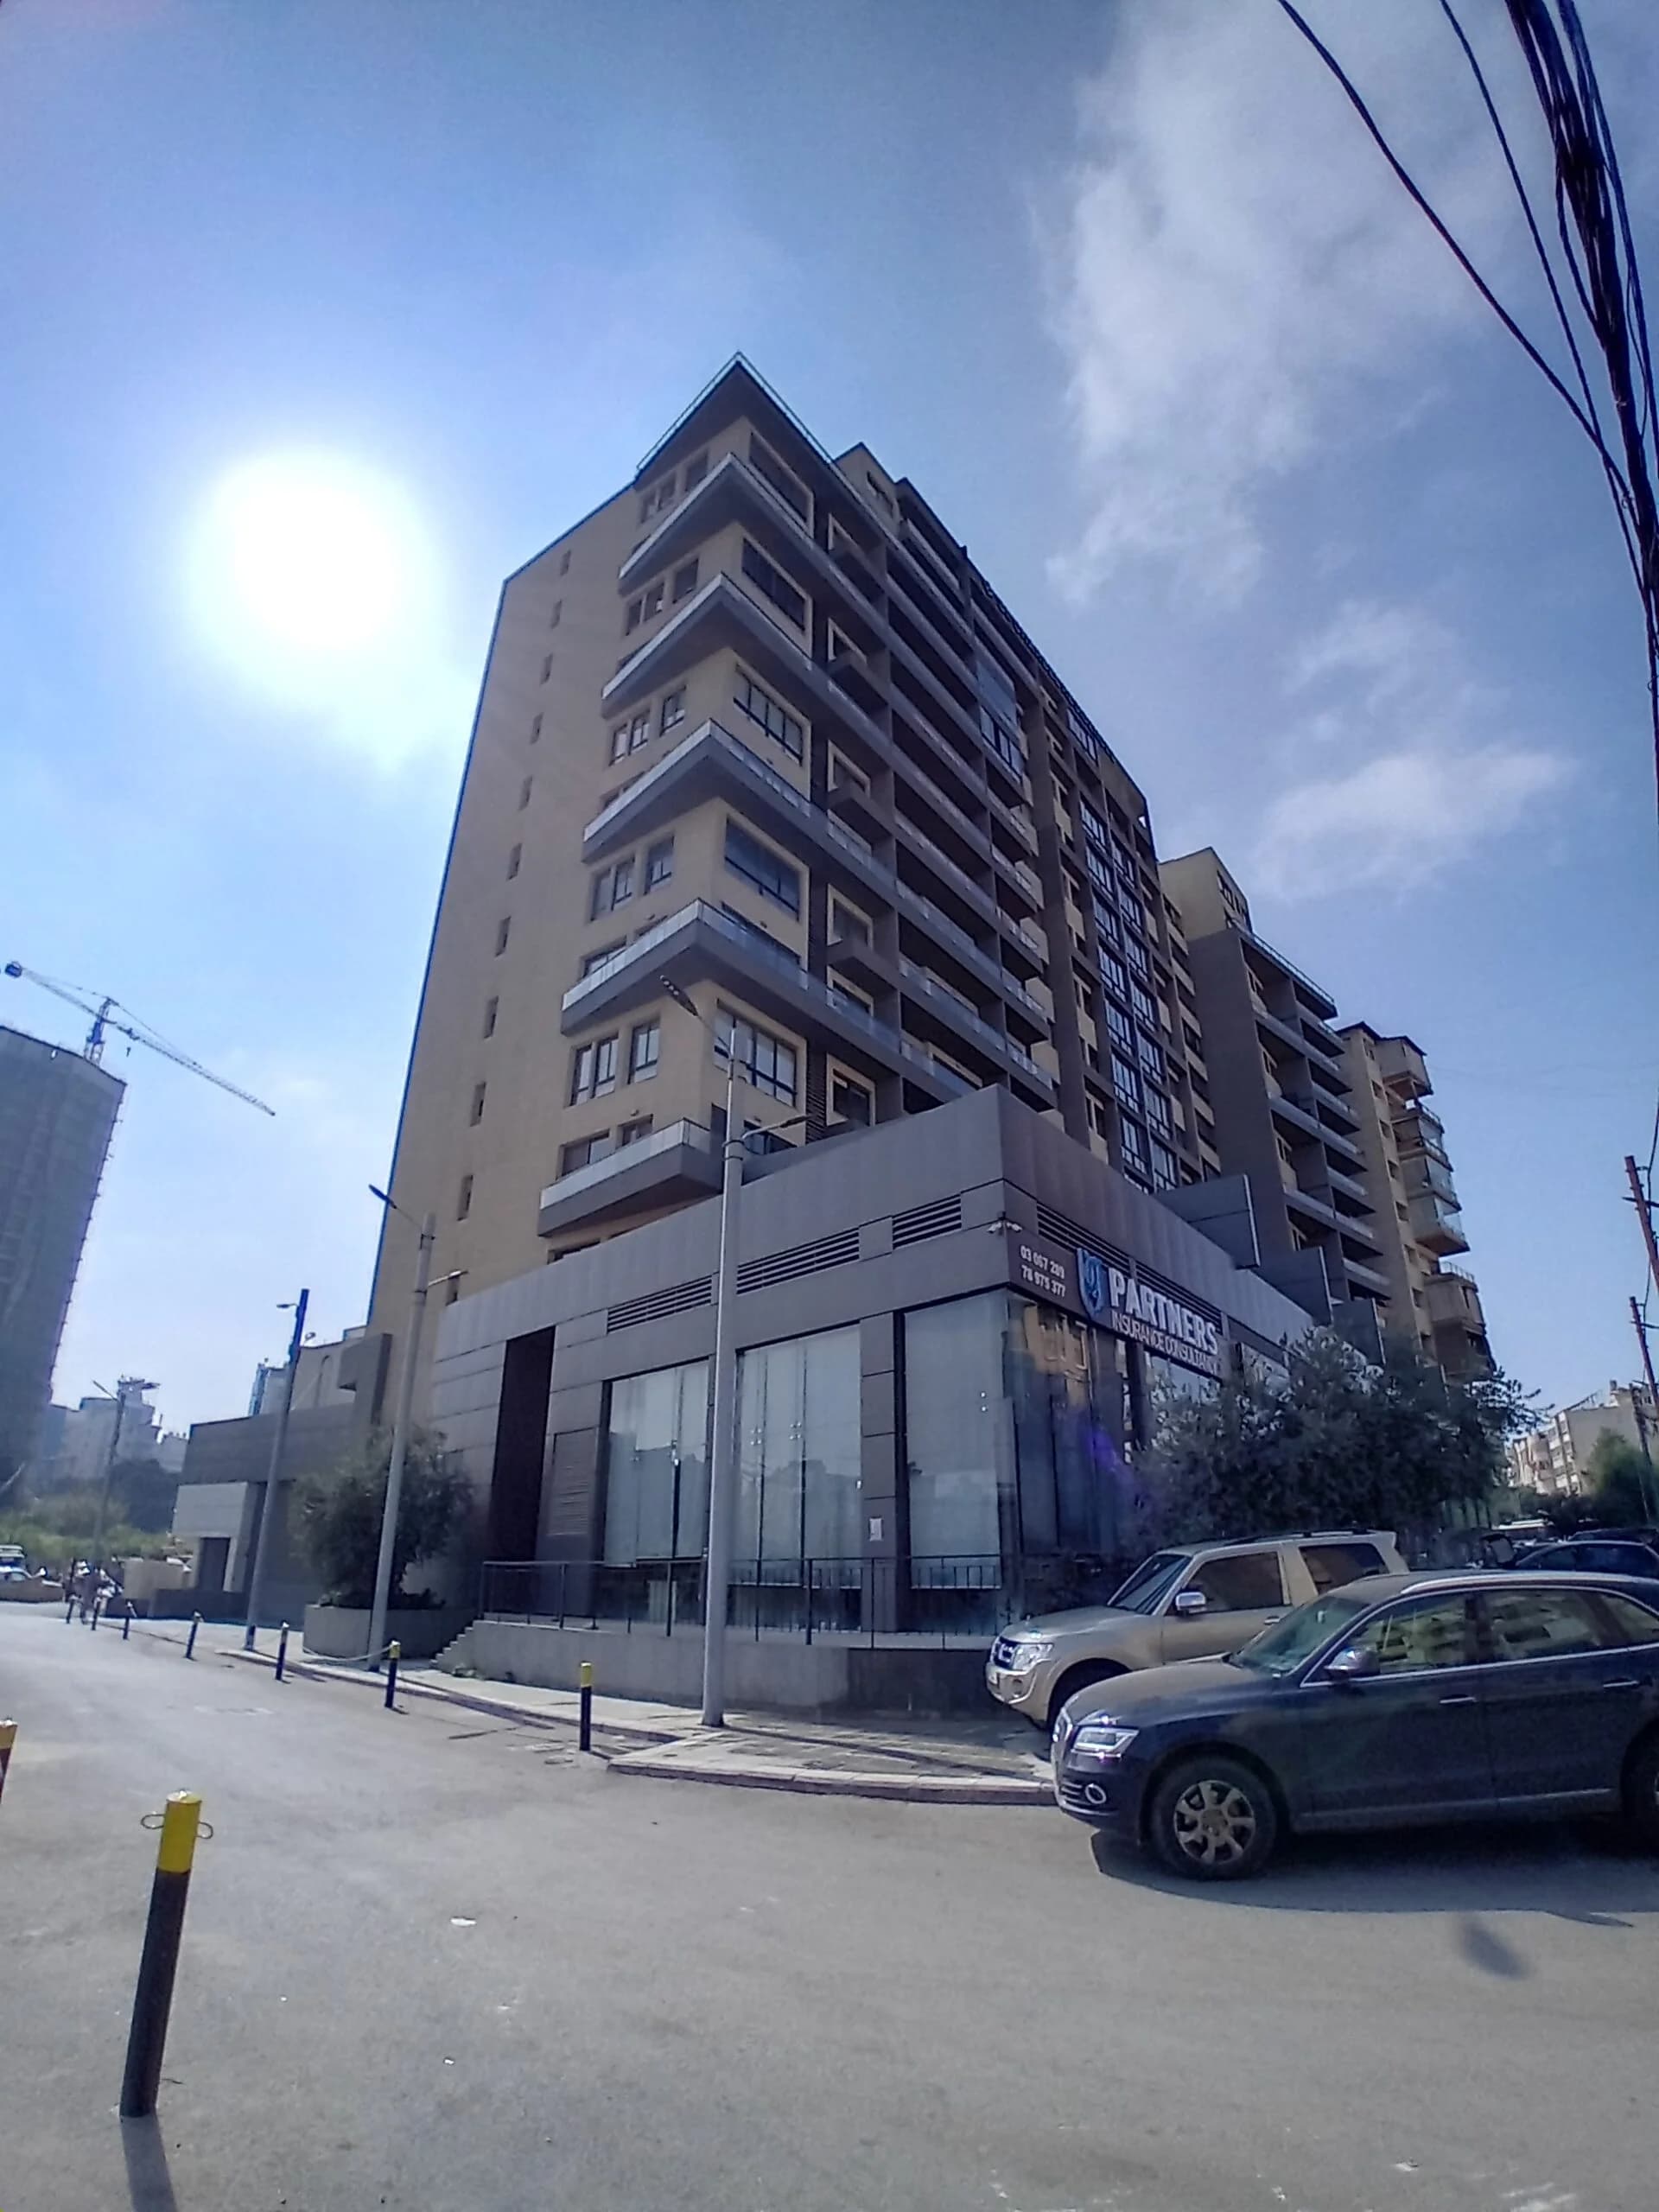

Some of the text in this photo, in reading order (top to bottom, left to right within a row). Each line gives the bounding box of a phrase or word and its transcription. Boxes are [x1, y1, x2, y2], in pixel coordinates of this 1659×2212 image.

[1020, 1245, 1032, 1262] 03
[1051, 1280, 1065, 1297] 377
[1109, 1267, 1217, 1356] PARTNERS
[1111, 1310, 1165, 1351] INSURANCE
